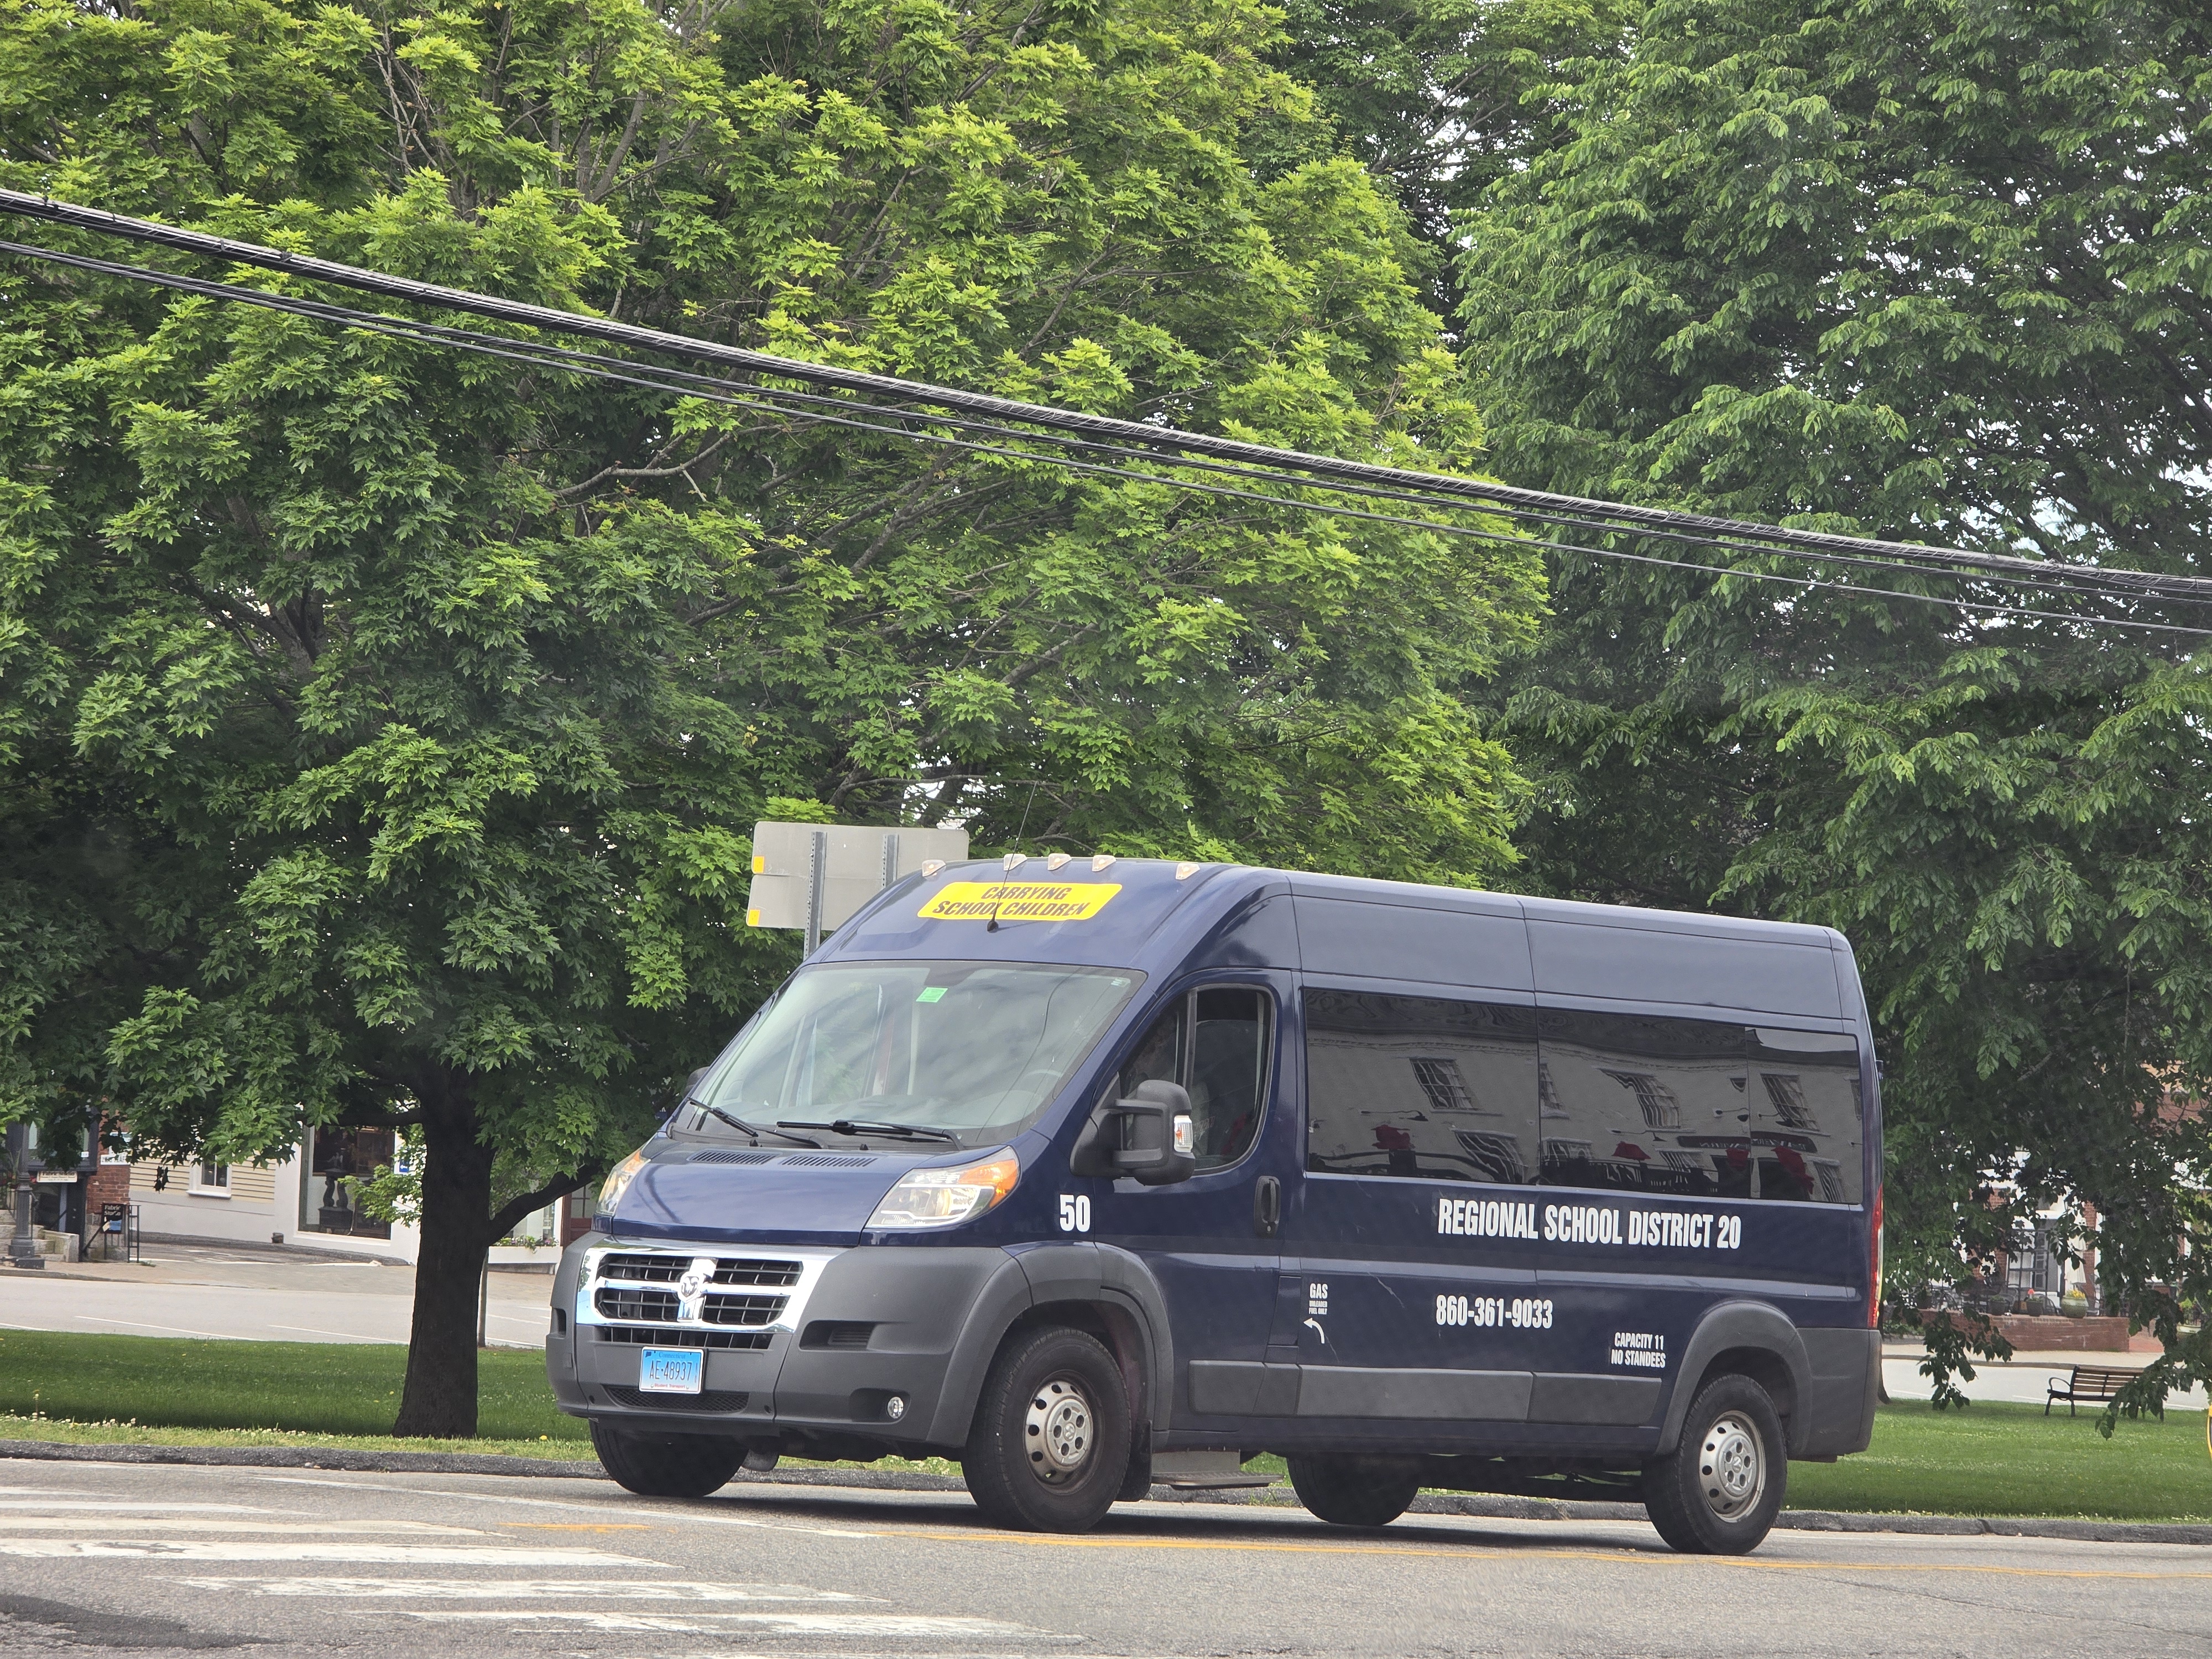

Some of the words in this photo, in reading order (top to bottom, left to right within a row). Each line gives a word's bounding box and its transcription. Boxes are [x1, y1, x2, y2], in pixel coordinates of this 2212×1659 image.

[981, 886, 1072, 900] CARRYING
[932, 900, 1004, 915] SCHOOL
[1001, 902, 1091, 916] CHILDREN
[1060, 1194, 1091, 1232] 50
[1438, 1198, 1538, 1239] REGIONAL
[1544, 1204, 1623, 1244] SCHOOL
[1628, 1210, 1714, 1248] DISTRICT
[1716, 1215, 1741, 1249] 20
[1310, 1283, 1328, 1299] GAS
[1436, 1295, 1553, 1329] 860-361-9033
[1614, 1332, 1653, 1349] CAPACITY
[1655, 1334, 1664, 1350] 11
[659, 1351, 686, 1359] Connecticut
[1611, 1349, 1624, 1365] NO
[1625, 1350, 1666, 1369] STANDEES
